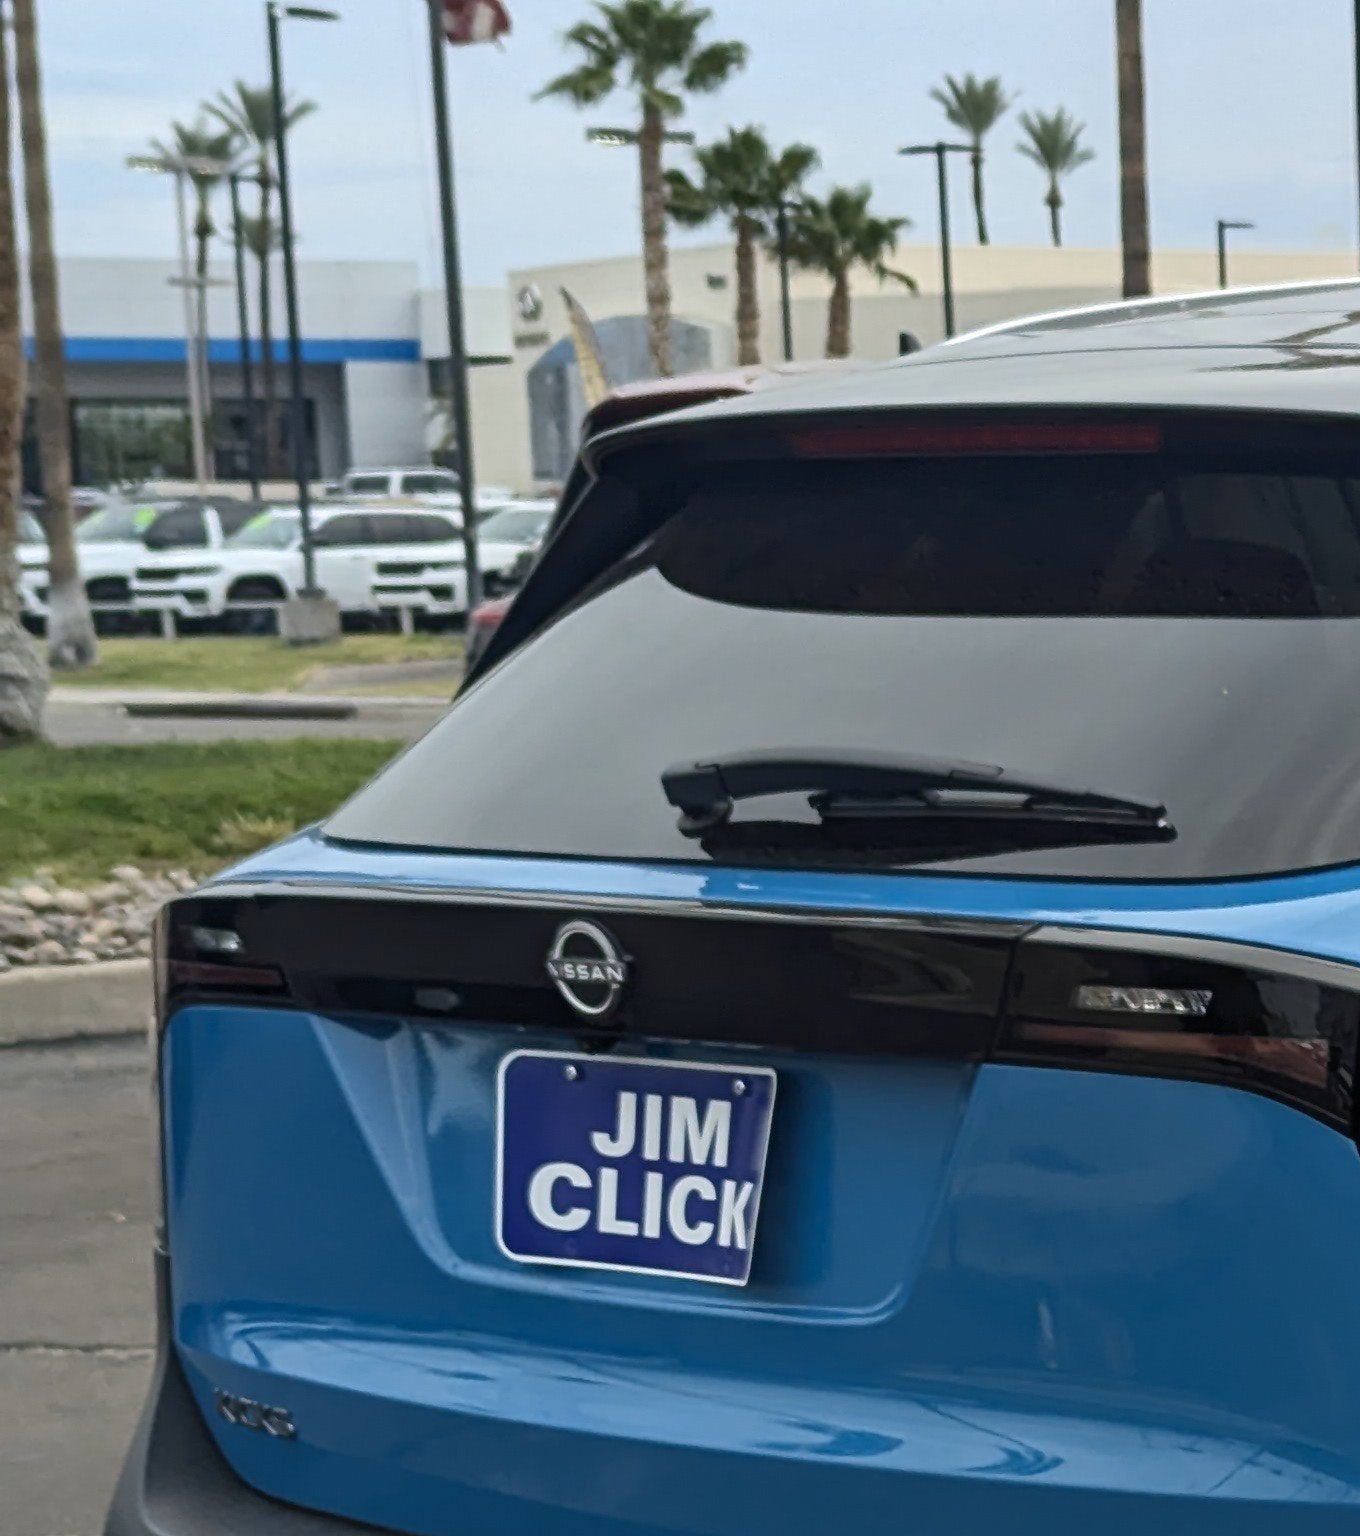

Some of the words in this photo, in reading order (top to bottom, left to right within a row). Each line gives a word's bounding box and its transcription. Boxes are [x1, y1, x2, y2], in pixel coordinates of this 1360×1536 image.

[546, 961, 624, 982] NSSAN
[590, 1090, 732, 1168] JIM
[528, 1161, 753, 1249] CLICK
